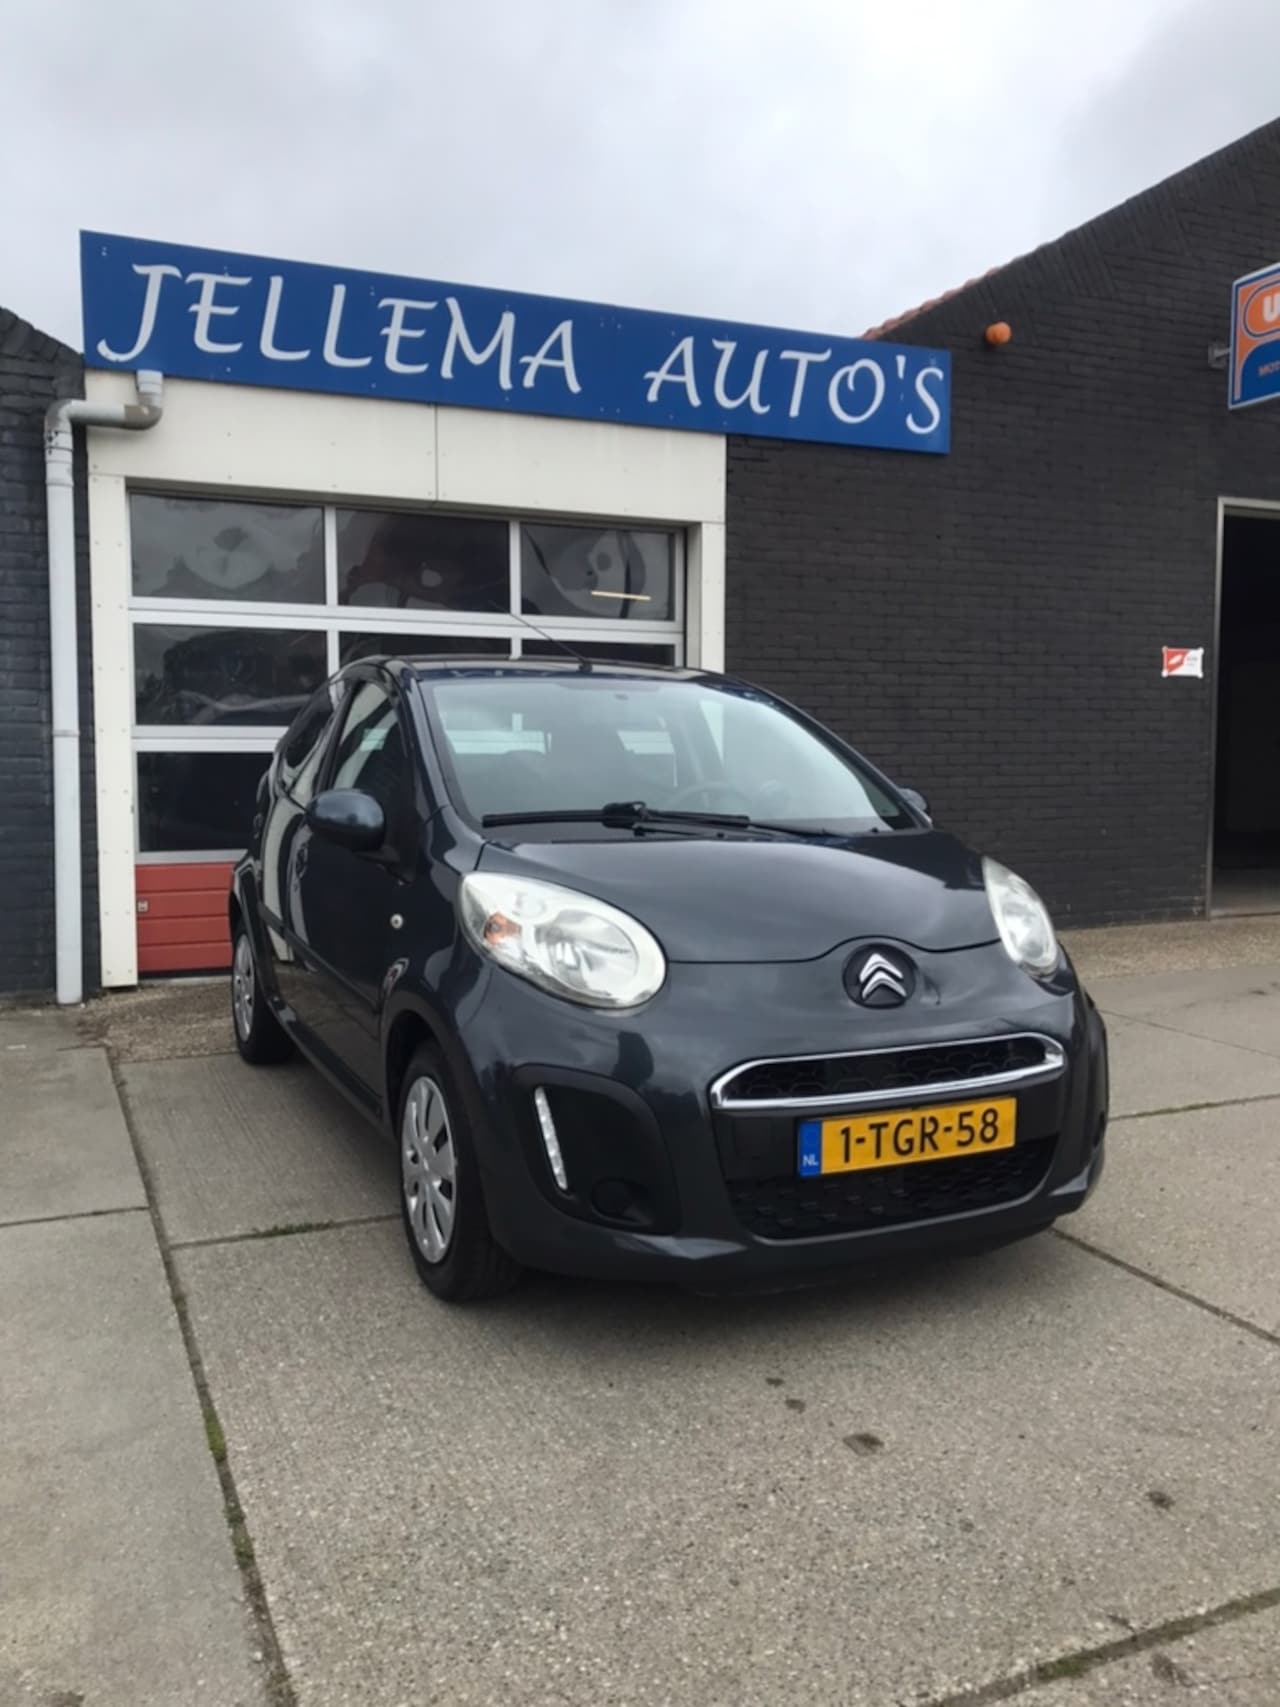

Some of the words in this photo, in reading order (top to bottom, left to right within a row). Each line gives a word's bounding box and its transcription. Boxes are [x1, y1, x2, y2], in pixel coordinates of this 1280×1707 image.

[96, 263, 582, 394] JELLEMA
[643, 336, 944, 435] AUTO'S
[803, 1154, 819, 1166] NL
[840, 1108, 999, 1163] 1-TGR-58
